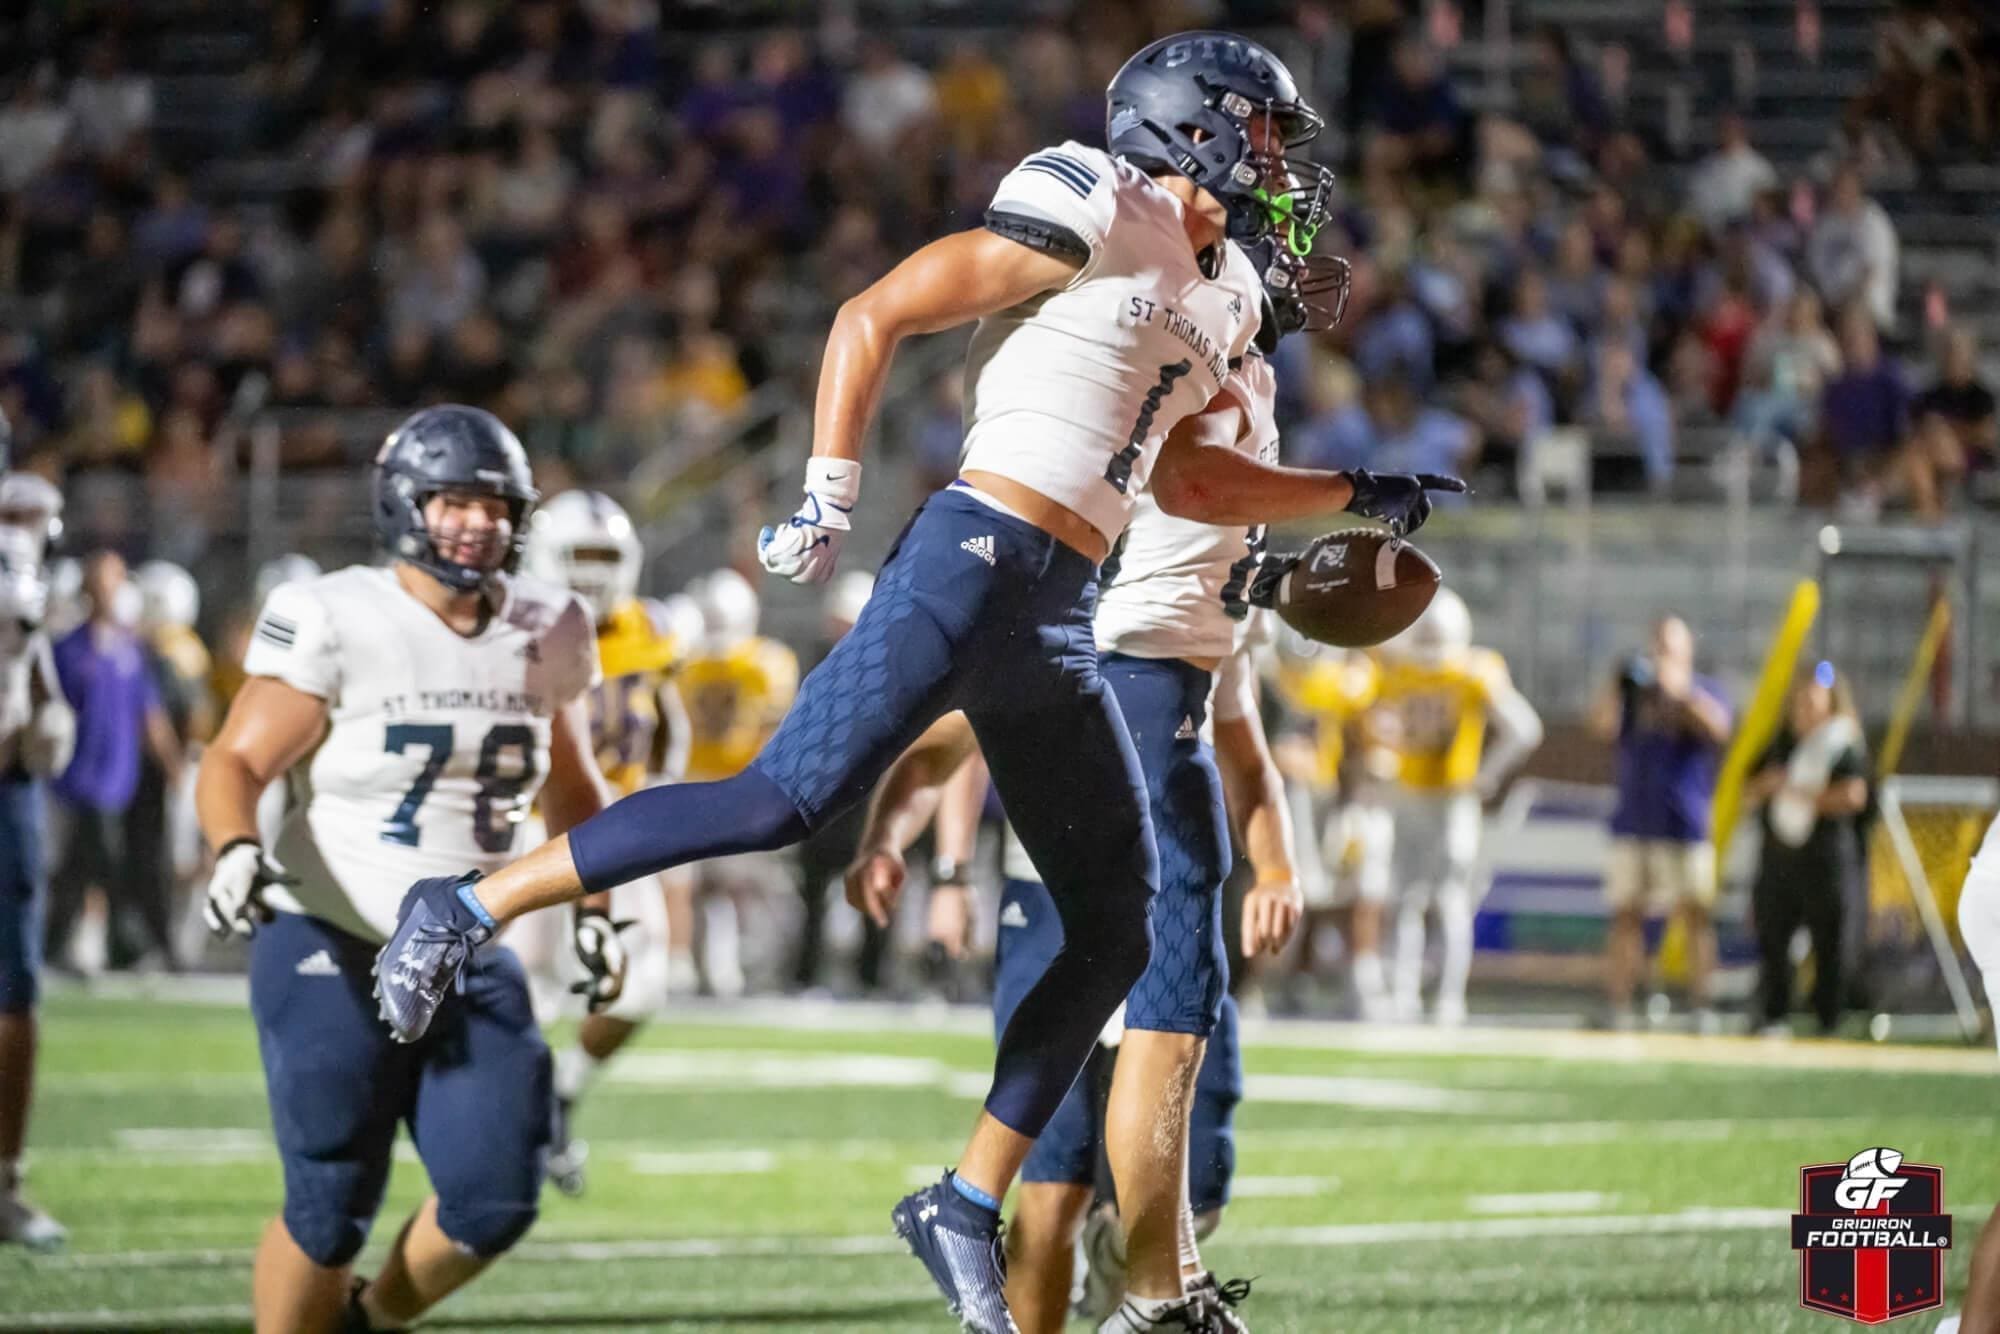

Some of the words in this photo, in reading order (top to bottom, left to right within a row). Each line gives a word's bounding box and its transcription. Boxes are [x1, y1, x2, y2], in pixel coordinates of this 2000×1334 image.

[1166, 40, 1267, 78] STM
[1129, 296, 1156, 322] ST
[1163, 307, 1211, 358] THOMAS
[1104, 357, 1192, 494] 1
[960, 541, 997, 567] adidas
[420, 689, 499, 711] THOMAS
[380, 724, 537, 853] 78
